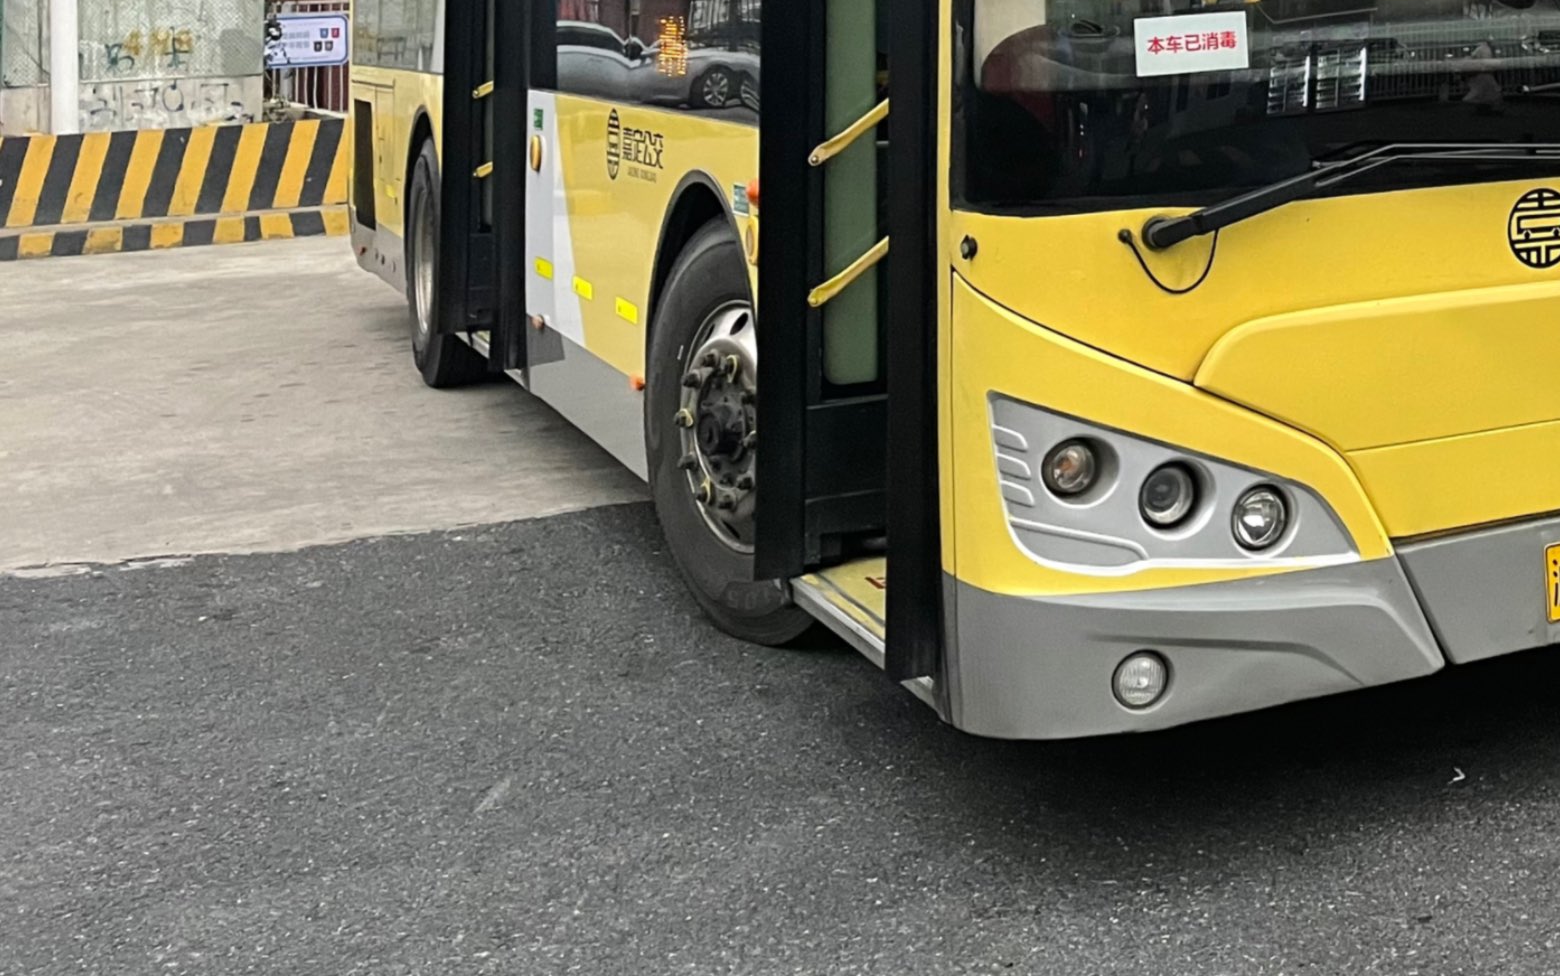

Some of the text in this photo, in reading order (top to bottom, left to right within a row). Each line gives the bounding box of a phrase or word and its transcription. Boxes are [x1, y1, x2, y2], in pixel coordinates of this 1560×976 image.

[1147, 30, 1238, 55] 本车已消毒
[622, 126, 665, 169] 嘉定公交
